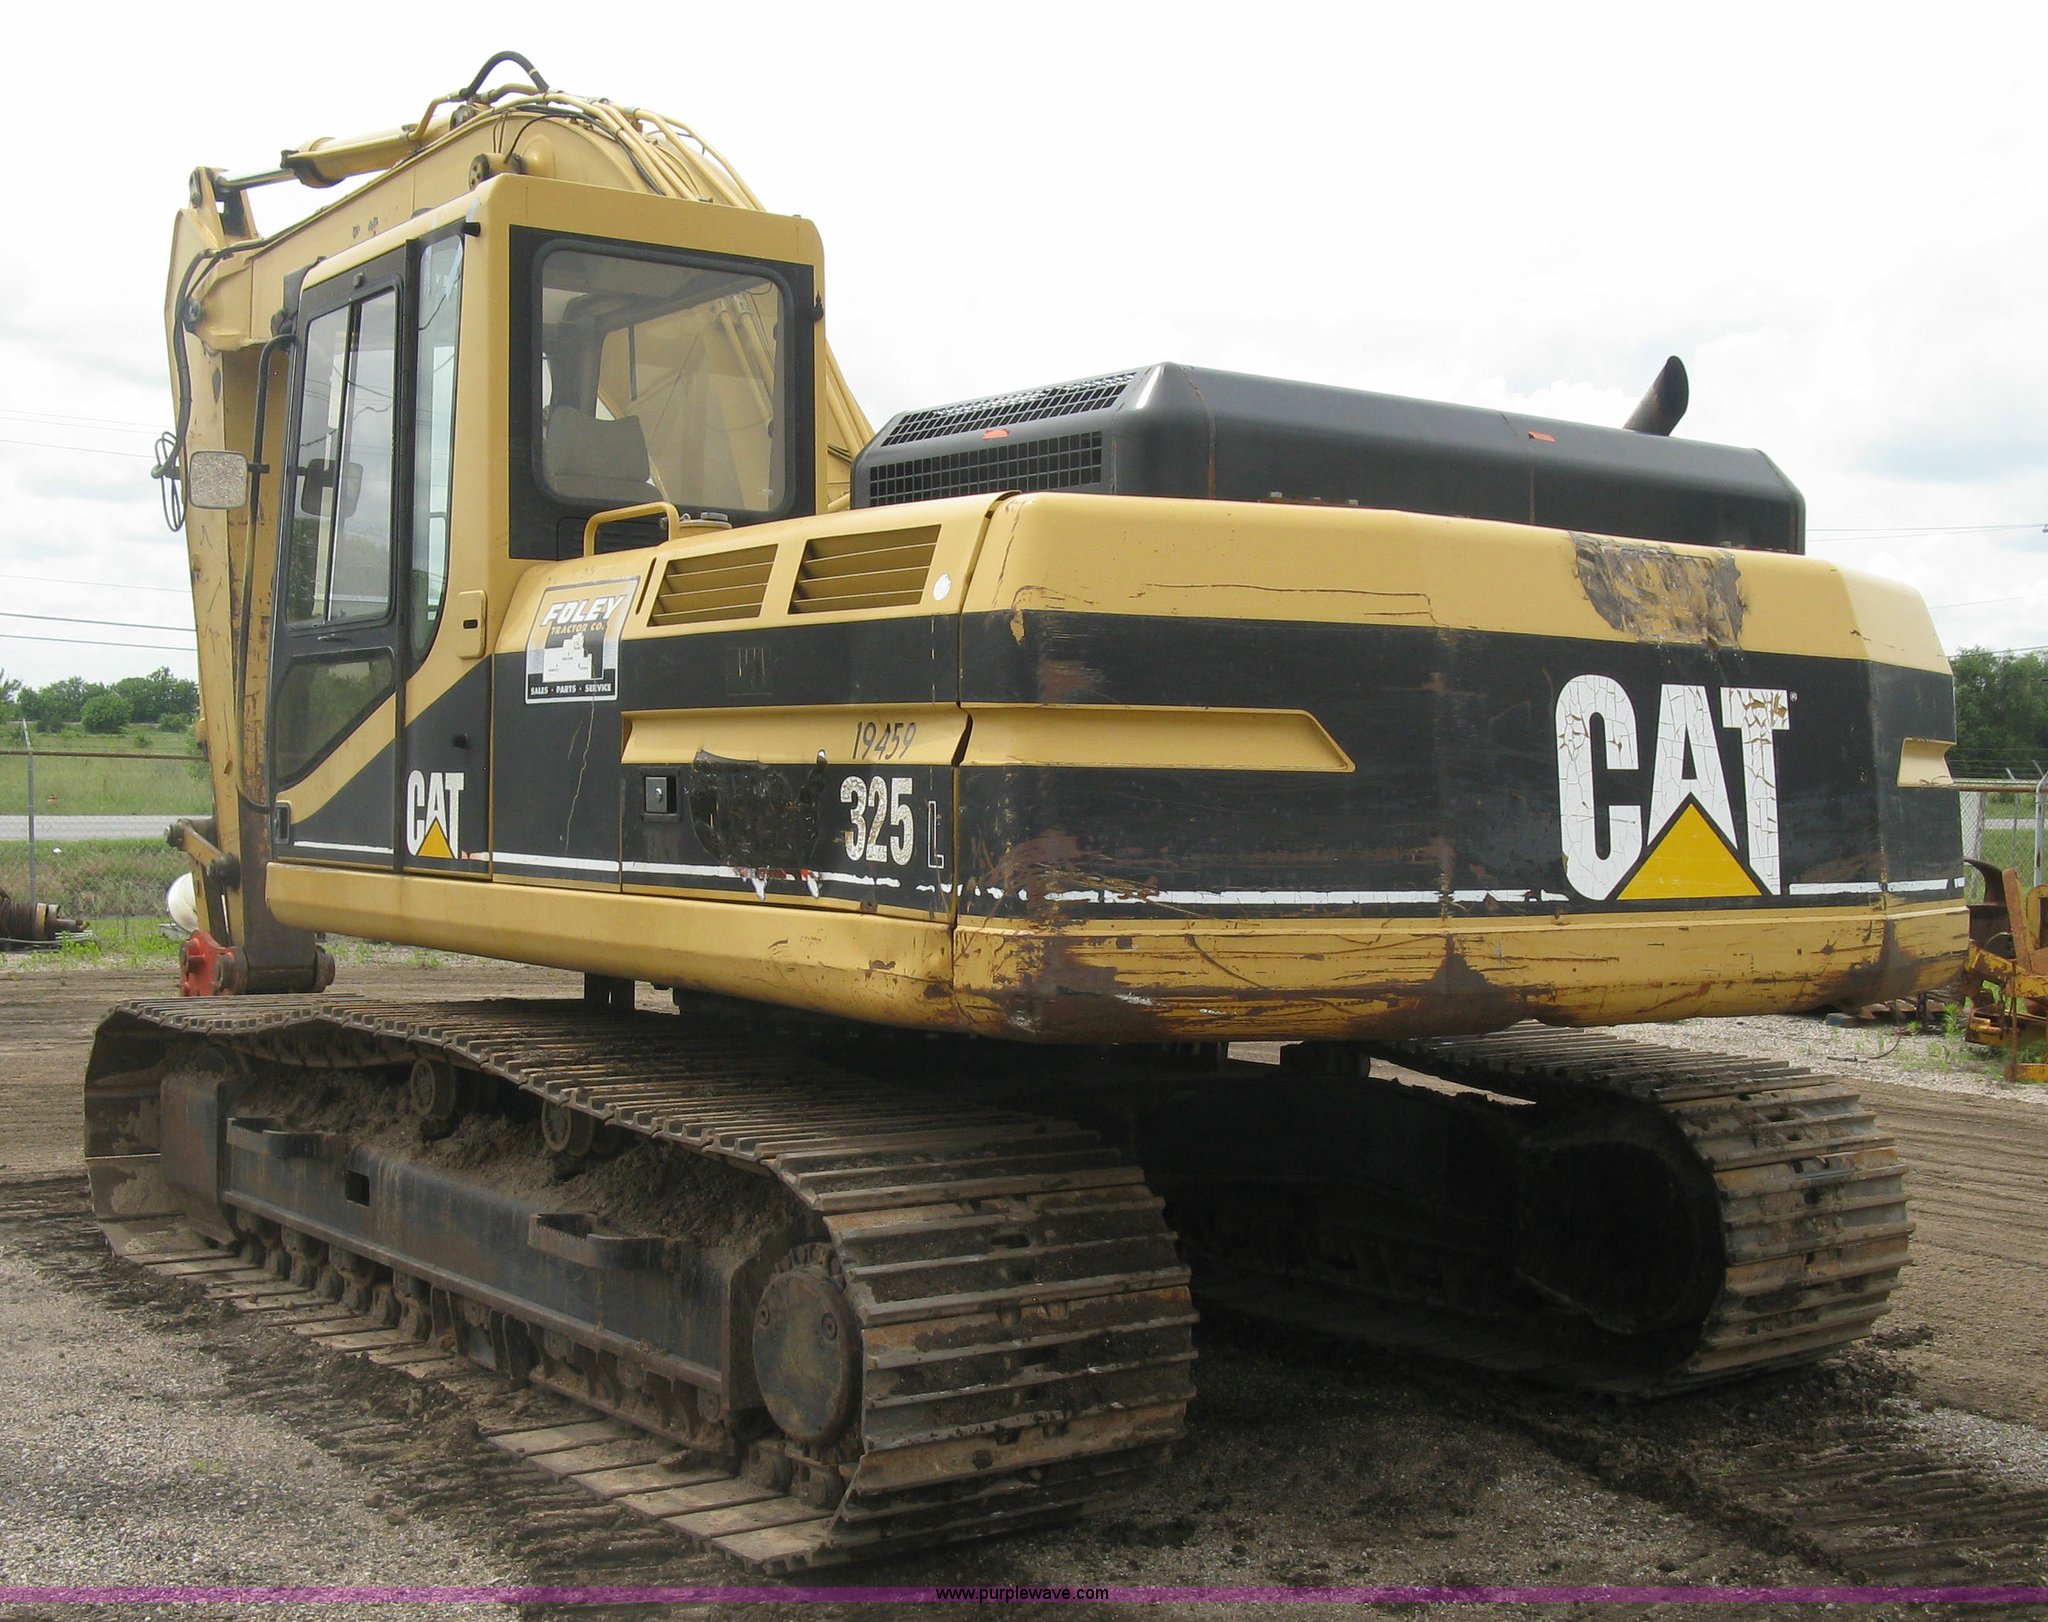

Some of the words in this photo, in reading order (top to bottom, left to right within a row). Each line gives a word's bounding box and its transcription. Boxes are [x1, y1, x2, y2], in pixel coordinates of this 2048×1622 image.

[541, 595, 625, 626] FOLEY
[551, 623, 587, 635] TRACTOR
[590, 622, 605, 631] CO.
[530, 685, 549, 696] SALES
[555, 684, 577, 694] PARTS
[584, 683, 612, 693] SERVICE
[852, 721, 917, 760] 19459
[1555, 674, 1790, 901] CAT
[406, 769, 465, 860] CAT
[840, 775, 915, 866] 325
[927, 800, 945, 869] L
